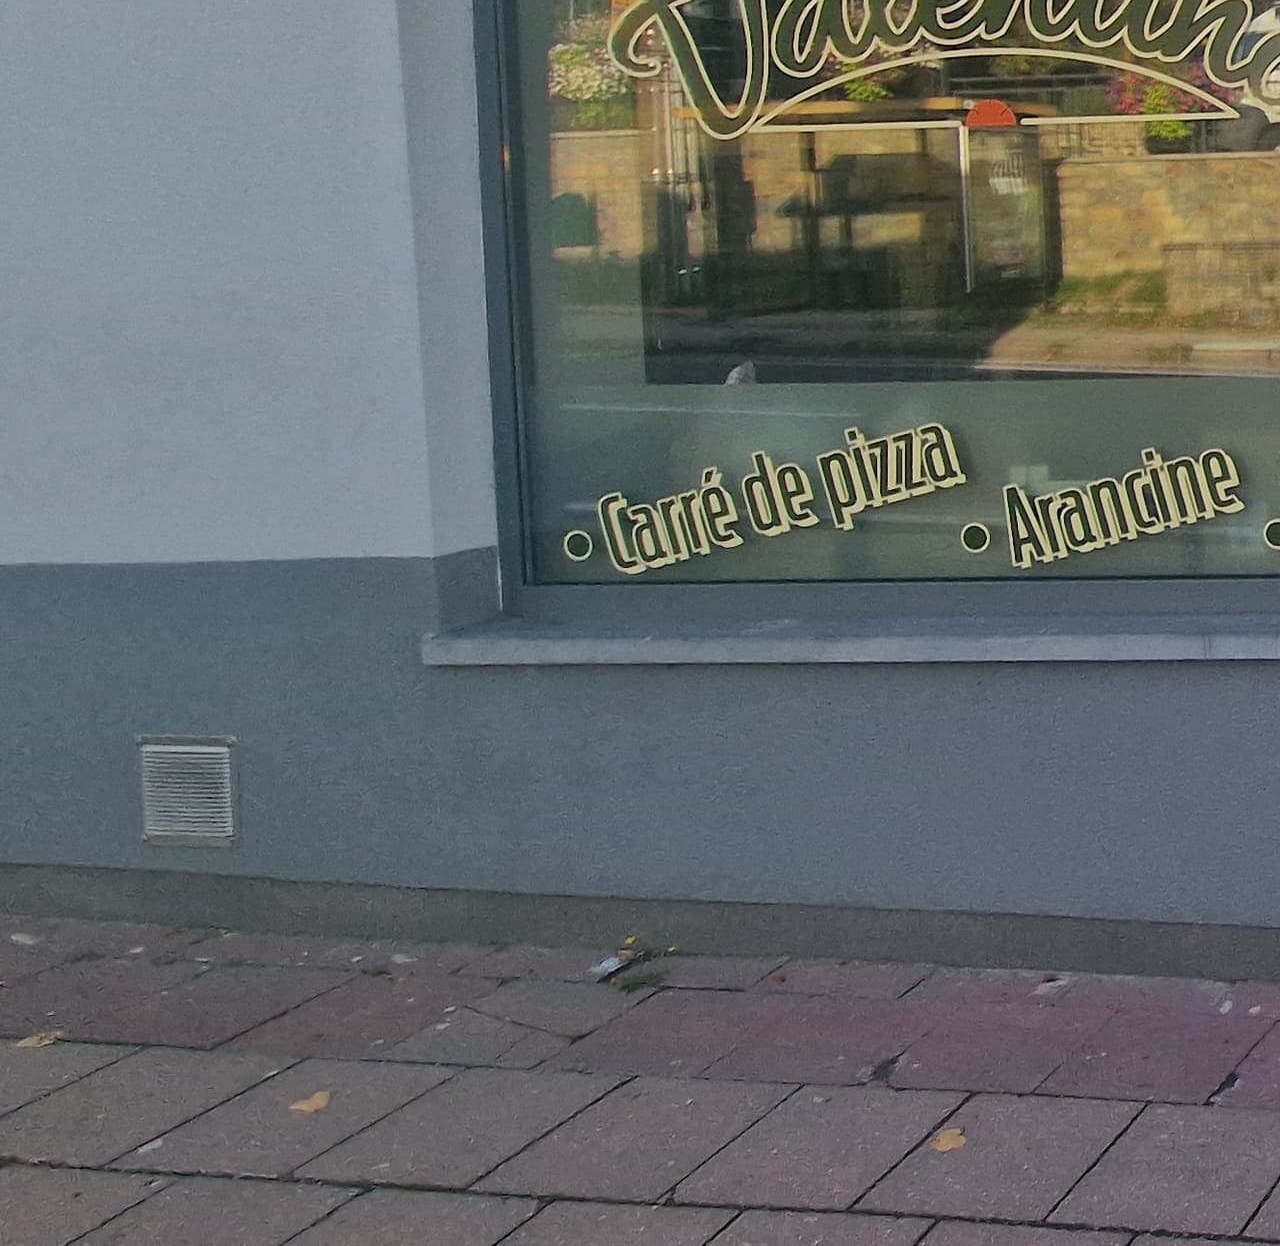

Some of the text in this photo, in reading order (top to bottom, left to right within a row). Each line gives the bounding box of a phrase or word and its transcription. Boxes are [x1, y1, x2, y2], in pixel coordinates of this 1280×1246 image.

[597, 421, 967, 575] Carré de pizza
[1003, 446, 1246, 569] Arancine
